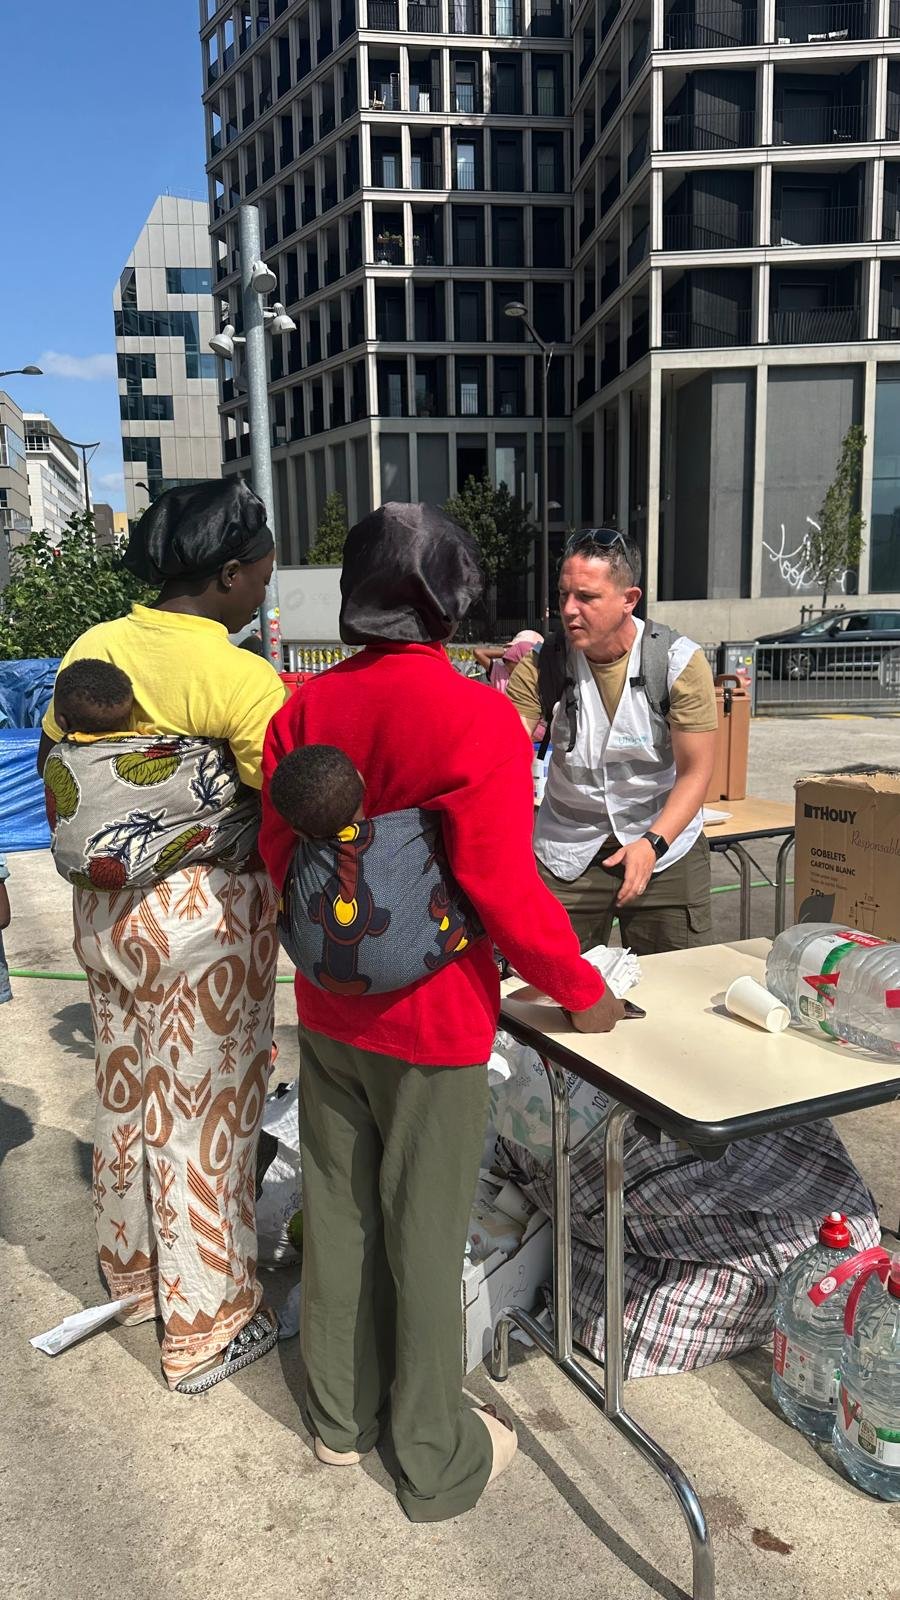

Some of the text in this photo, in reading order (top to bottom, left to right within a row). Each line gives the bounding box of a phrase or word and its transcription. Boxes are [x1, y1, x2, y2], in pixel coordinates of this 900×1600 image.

[812, 805, 857, 825] THOUY
[810, 847, 847, 862] GOBELETS
[810, 859, 835, 872] CARTON
[835, 866, 856, 876] BLANC
[591, 1090, 610, 1112] 100
